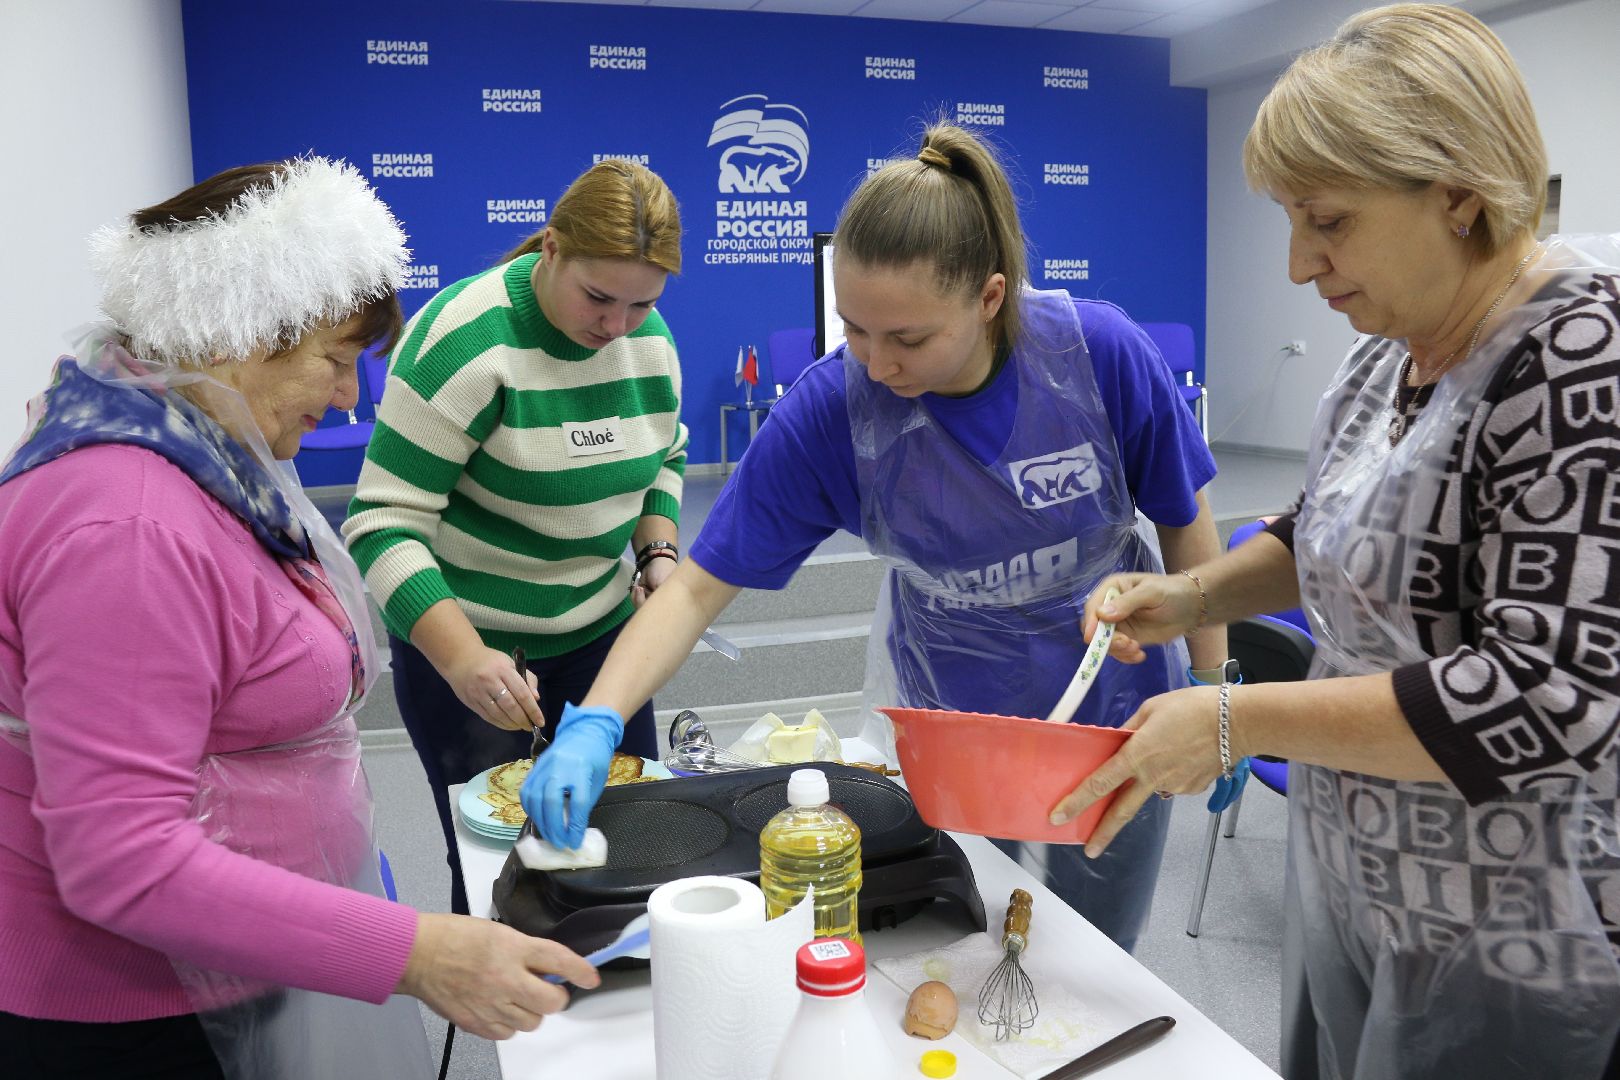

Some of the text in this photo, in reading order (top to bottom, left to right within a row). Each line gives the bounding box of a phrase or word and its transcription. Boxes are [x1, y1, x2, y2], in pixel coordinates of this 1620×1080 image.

[367, 40, 428, 52] ЕДИНАЯ
[590, 45, 646, 57] ЕДИНАЯ
[367, 53, 428, 65] РОССИЯ
[590, 58, 646, 70] РОССИЯ
[865, 57, 915, 68] ЕДИНАЯ
[866, 68, 915, 80] РОССИЯ
[1044, 67, 1088, 78] ЕДИНАЯ
[1044, 78, 1088, 89] РОССИЯ
[482, 89, 541, 100] ЕДИНАЯ
[483, 101, 541, 112] РОССИЯ
[957, 103, 1004, 114] ЕДИНАЯ
[957, 114, 1004, 126] РОССИЯ
[372, 153, 433, 165] ЕДИНАЯ
[373, 166, 433, 177] РОССИЯ
[1044, 164, 1089, 174] ЕДИНАЯ
[1044, 175, 1089, 185] РОССИЯ
[487, 199, 545, 211] ЕДИНАЯ
[716, 201, 807, 218] ЕДИНАЯ
[488, 212, 546, 223] РОССИЯ
[717, 220, 807, 237] РОССИЯ
[708, 237, 777, 251] ГОРОДСКОЙ
[705, 252, 779, 264] СЕРЕБРЯНЫЕ
[1045, 260, 1088, 269] ЕДИНАЯ
[1045, 270, 1088, 280] РОССИЯ
